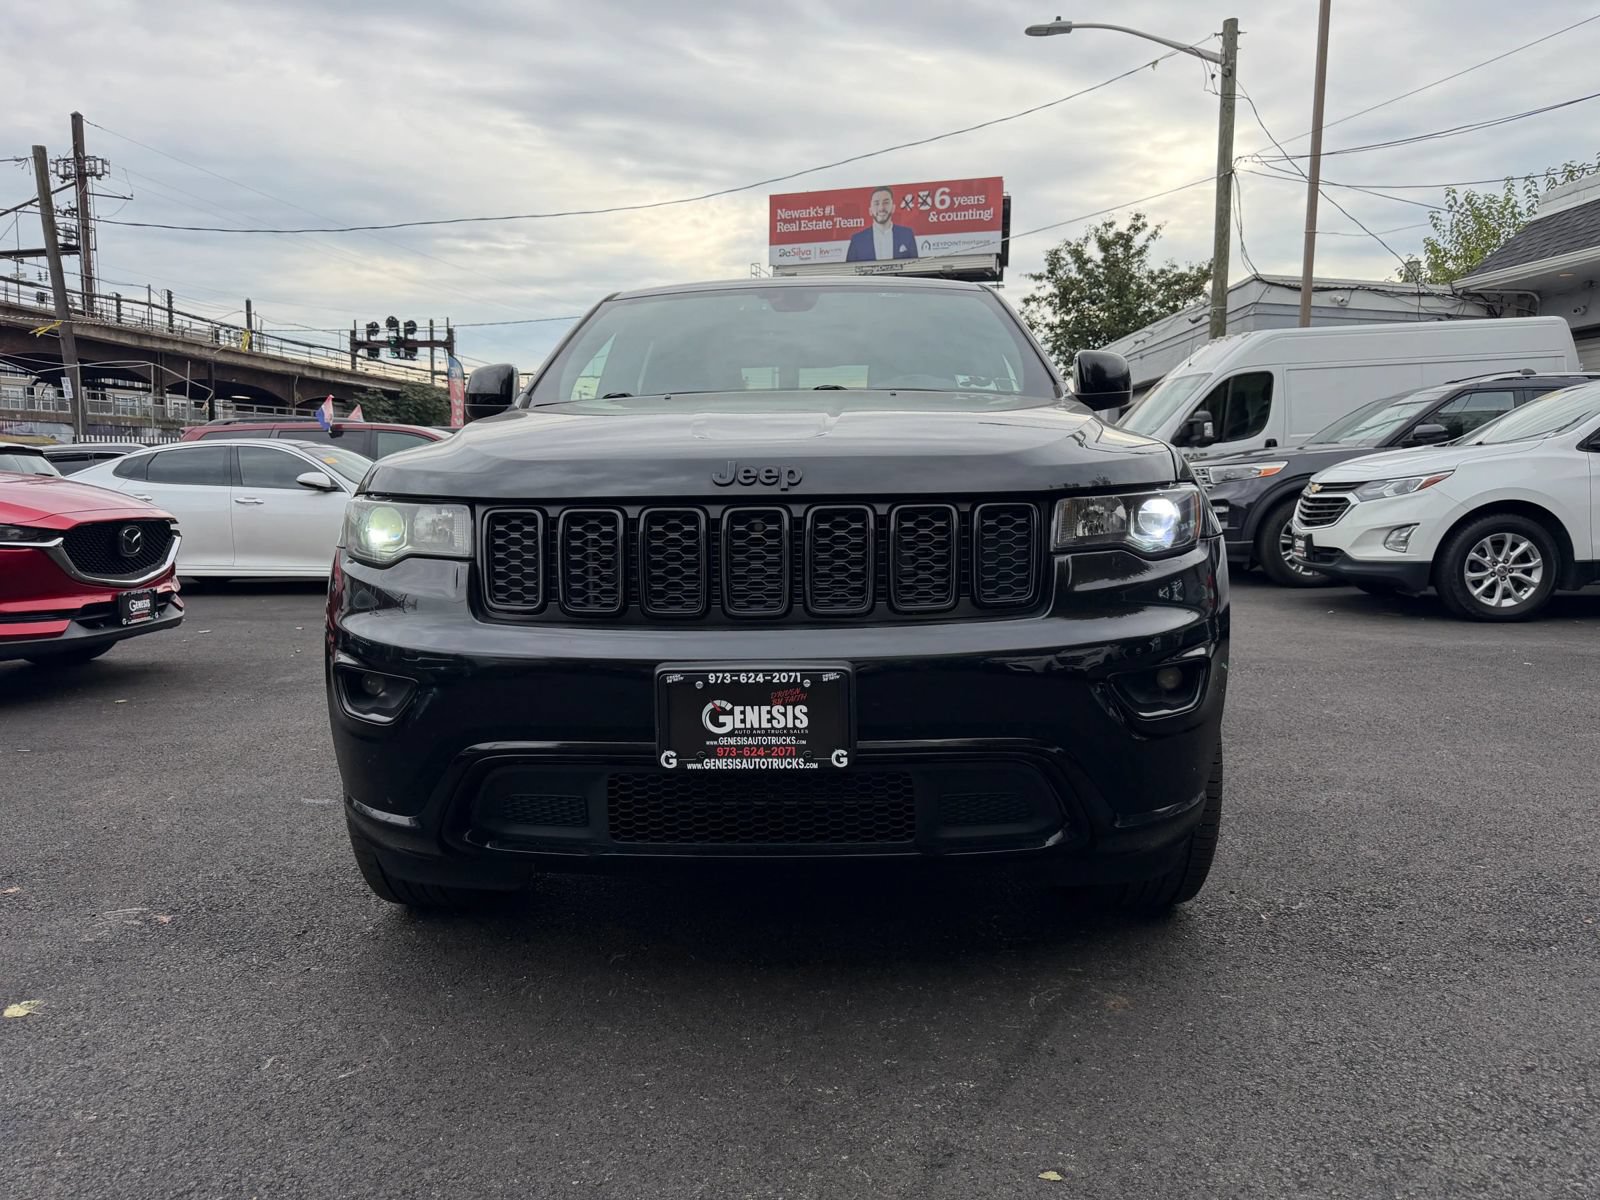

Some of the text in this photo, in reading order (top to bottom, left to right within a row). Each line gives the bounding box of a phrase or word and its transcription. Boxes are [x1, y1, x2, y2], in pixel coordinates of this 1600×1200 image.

[934, 187, 951, 210] 6
[953, 194, 985, 208] years
[776, 205, 835, 220] Newark's #1
[928, 207, 994, 222] & counting!
[776, 217, 865, 233] Real Estate Team
[712, 460, 803, 491] Jeep
[129, 599, 151, 611] GENESIS
[708, 672, 801, 684] 973-624-2071
[701, 699, 809, 734] GENESIS
[716, 746, 797, 757] 973-624-2071
